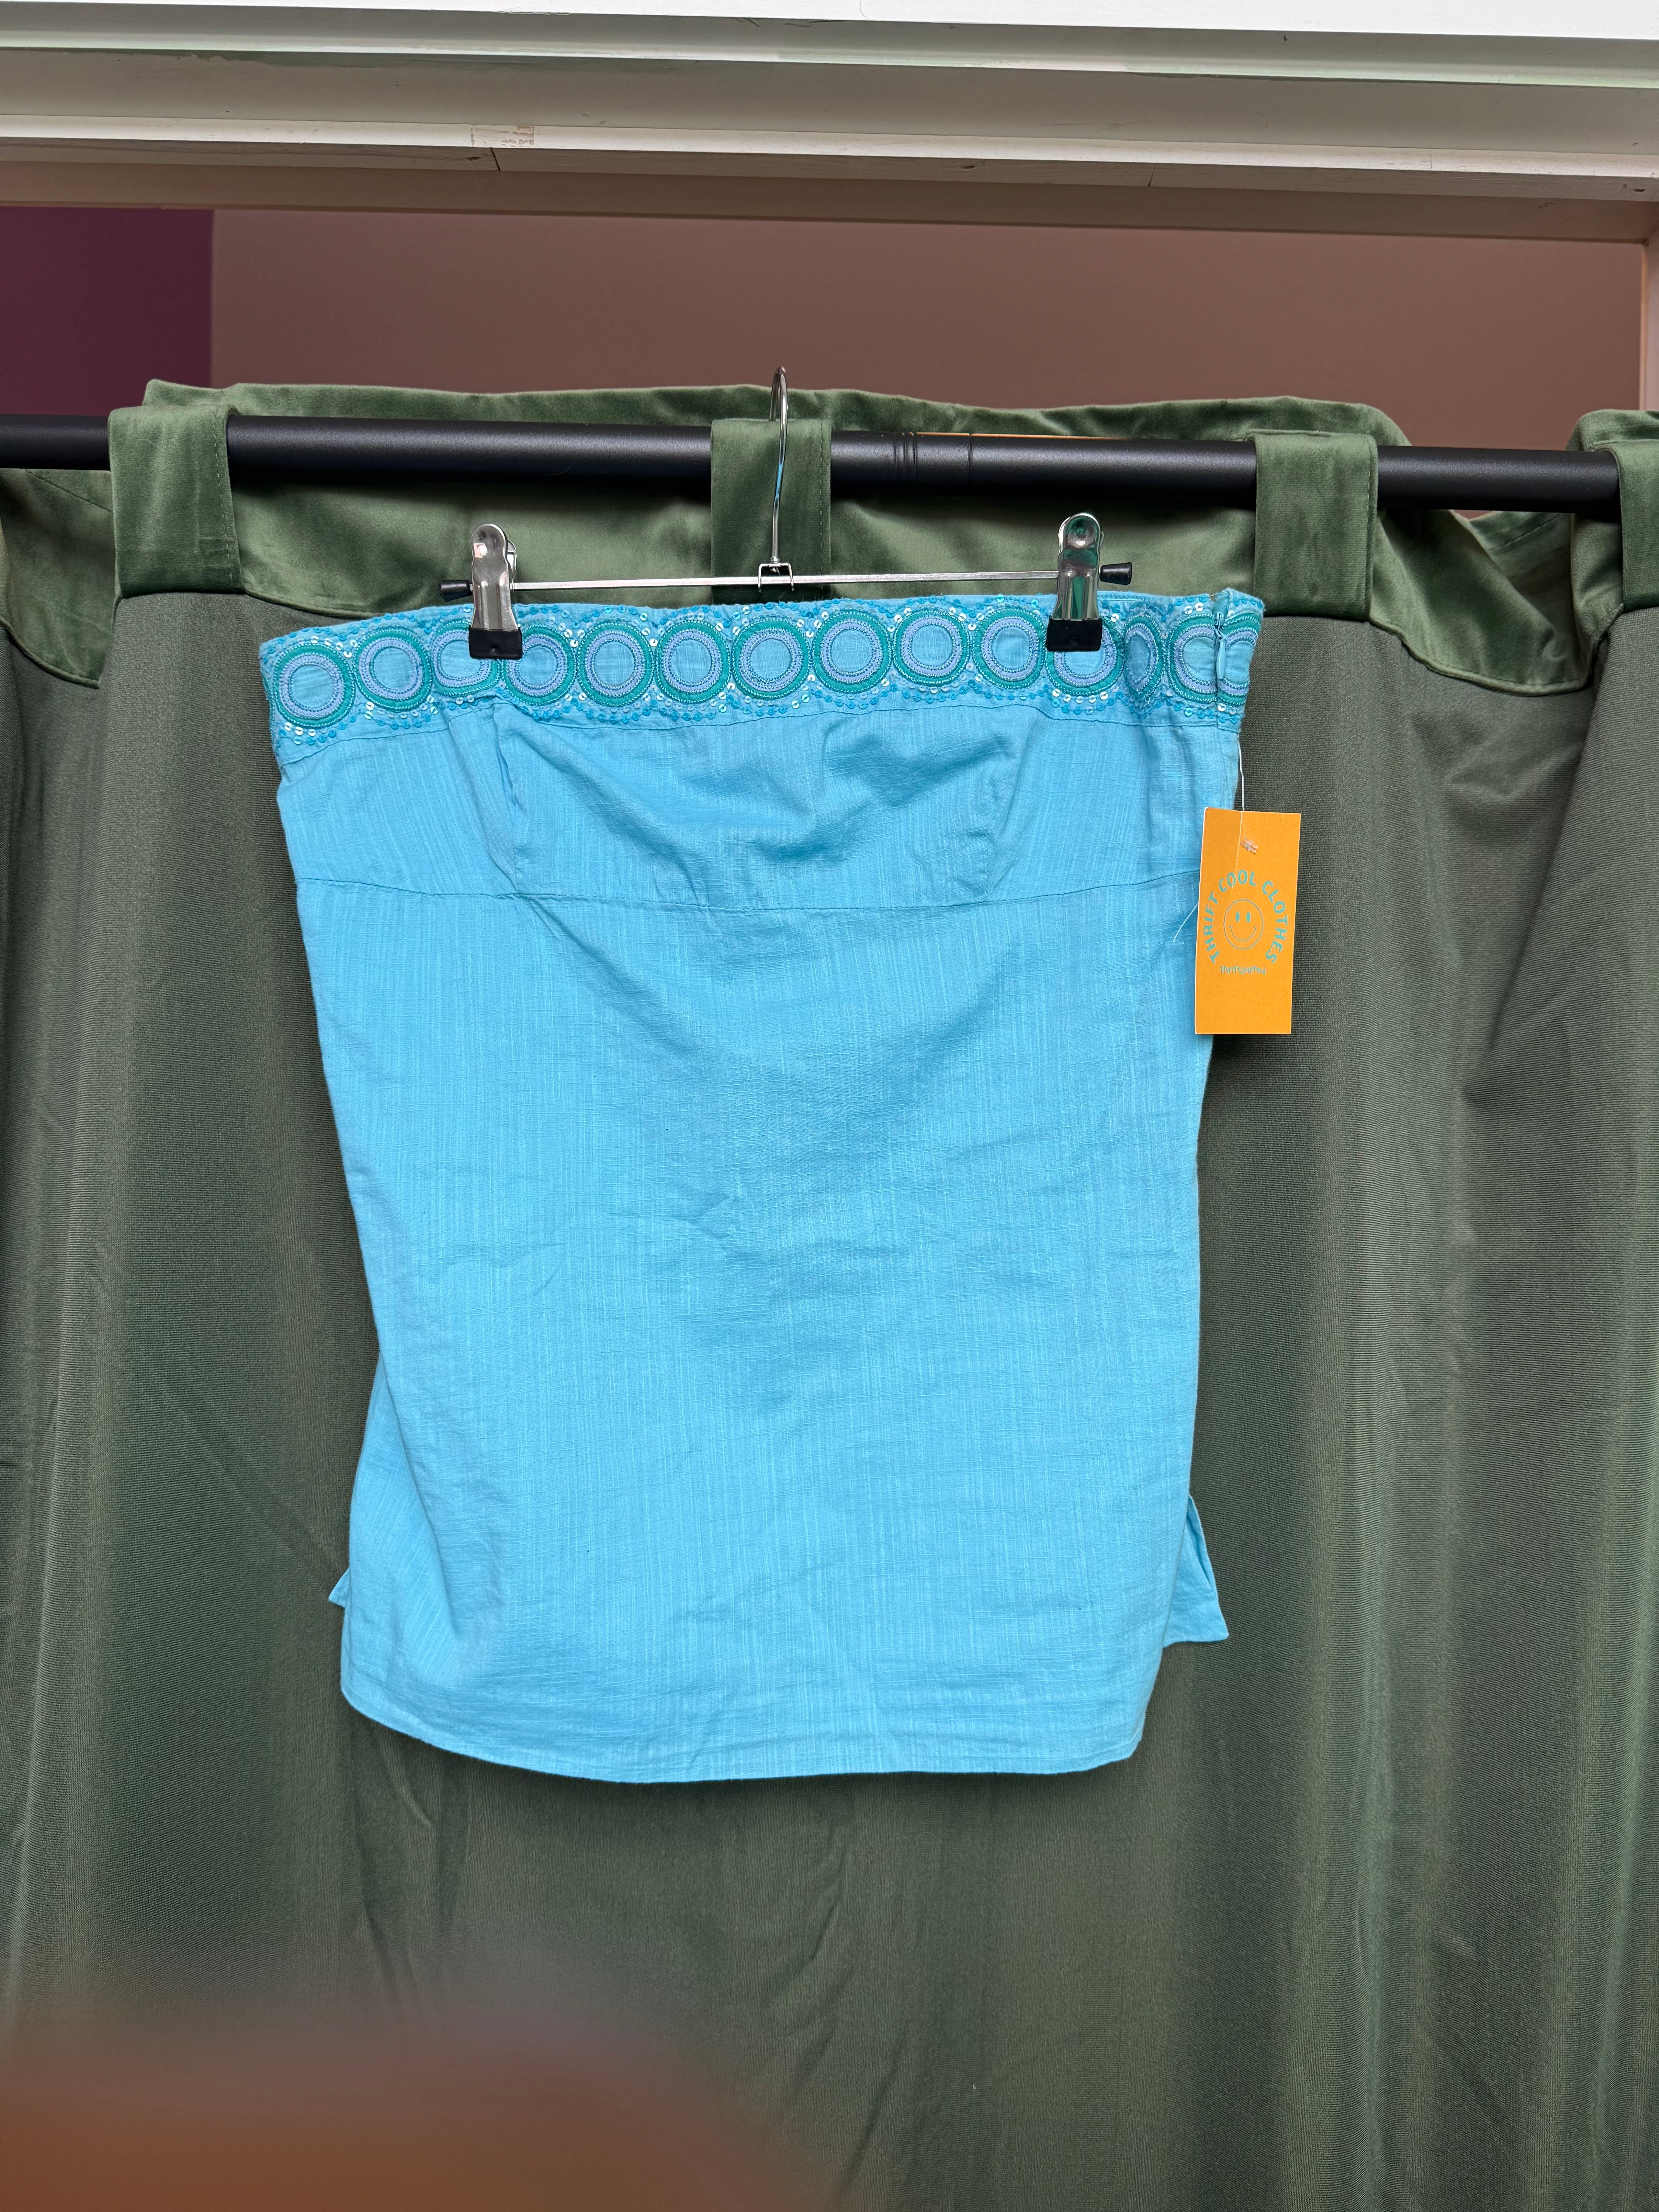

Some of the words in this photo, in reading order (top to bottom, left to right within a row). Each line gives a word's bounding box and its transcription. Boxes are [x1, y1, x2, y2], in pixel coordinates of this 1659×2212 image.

[1204, 891, 1219, 963] THRIFT
[1218, 869, 1256, 892] COOL
[1262, 880, 1288, 963] CLOTHES
